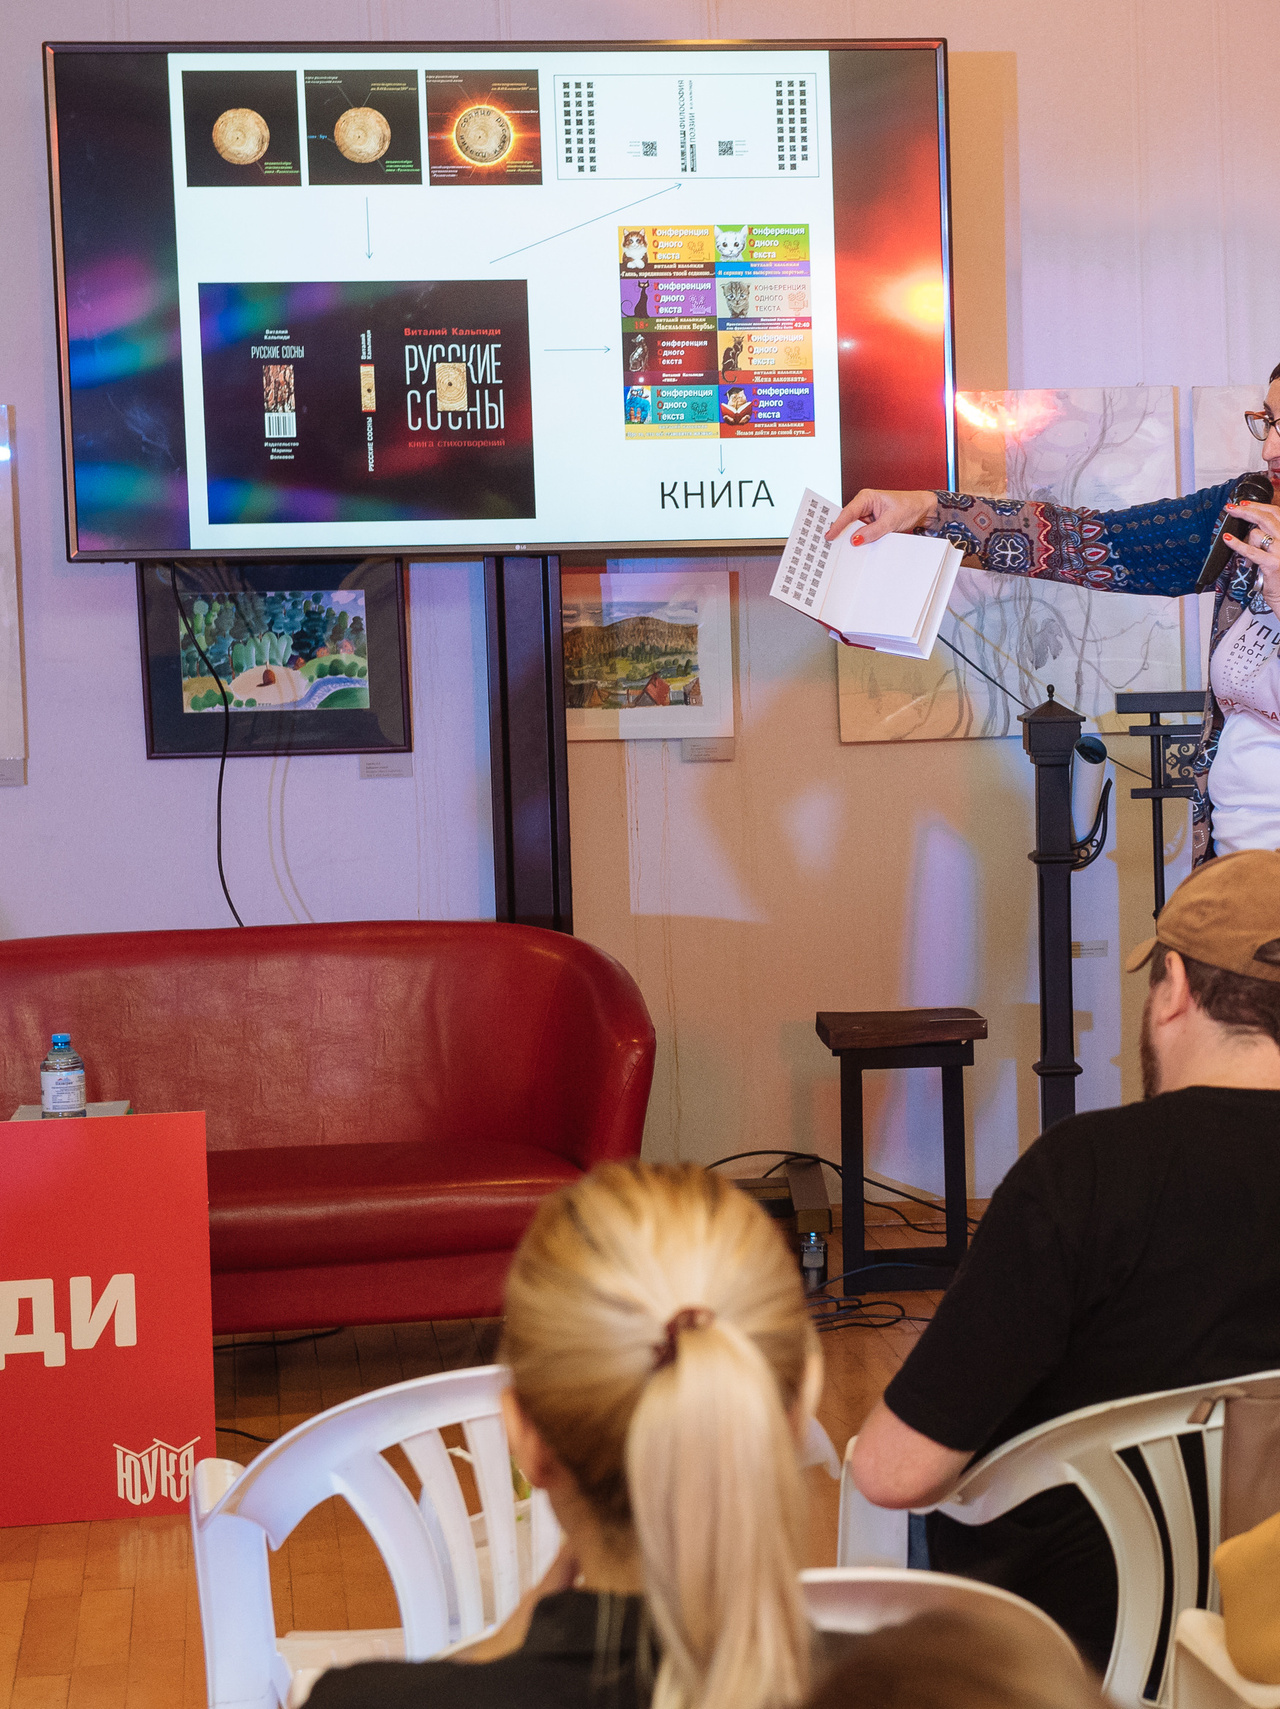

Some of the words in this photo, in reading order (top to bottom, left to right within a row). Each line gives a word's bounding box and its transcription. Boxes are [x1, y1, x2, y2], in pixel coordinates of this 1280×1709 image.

[652, 228, 709, 238] Конференция
[748, 226, 805, 236] Конференция
[652, 240, 683, 249] Одного
[748, 238, 779, 247] Одного
[653, 252, 680, 260] Текста
[749, 250, 776, 259] Текста
[654, 282, 711, 292] Конференция
[654, 294, 685, 302] Одного
[654, 306, 682, 314] Текста
[452, 328, 501, 336] Кальпиди
[747, 334, 804, 343] Конференция
[251, 346, 280, 359] РУССКИЕ
[281, 345, 304, 358] СОСНЫ
[748, 346, 778, 354] Одного
[748, 357, 775, 365] Текста
[656, 389, 713, 398] Конференция
[752, 387, 809, 397] Конференция
[657, 400, 687, 409] Одного
[752, 399, 783, 407] Одного
[657, 412, 684, 420] Текста
[752, 410, 780, 418] Текста
[438, 439, 505, 448] стихотворений
[660, 480, 774, 509] КНИГА
